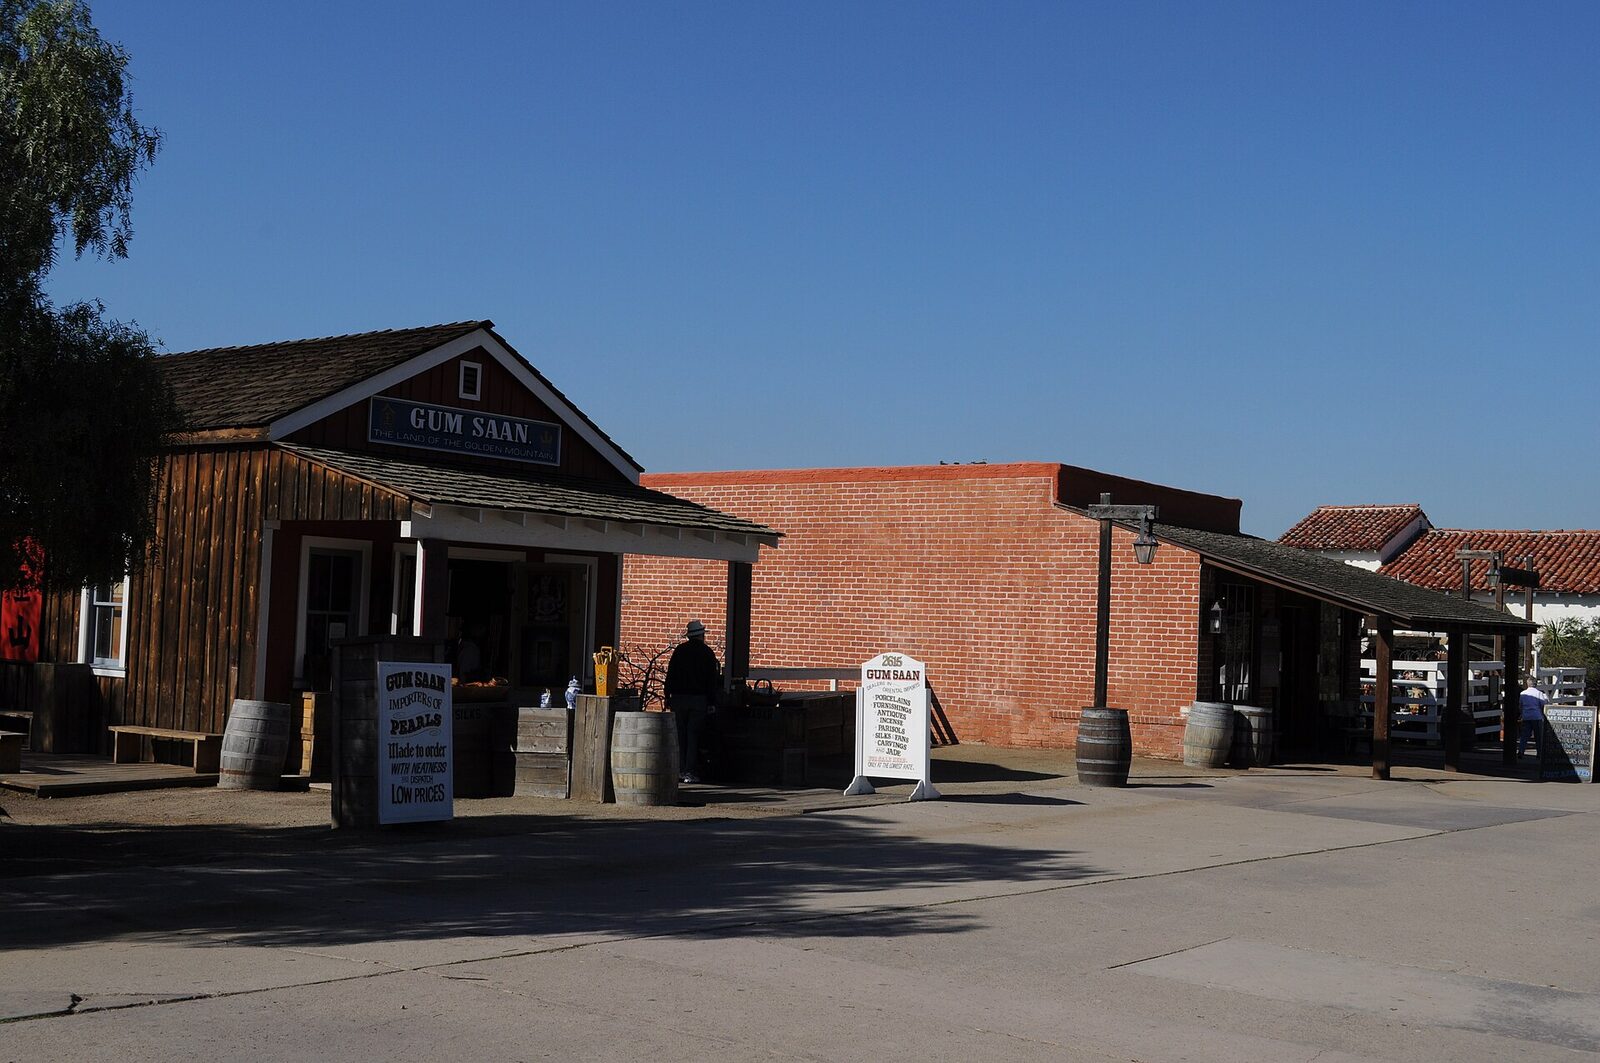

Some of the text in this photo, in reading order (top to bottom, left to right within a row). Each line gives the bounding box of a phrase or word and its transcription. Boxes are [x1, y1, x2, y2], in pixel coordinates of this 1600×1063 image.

[410, 407, 532, 445] GUM SAAN.
[373, 428, 394, 440] THE
[396, 432, 425, 444] LAND
[428, 435, 440, 445] OF
[444, 438, 462, 449] THE
[464, 440, 503, 453] GOLDEN
[881, 655, 903, 667] 2615
[866, 669, 920, 681] GUM SAAN
[386, 671, 446, 693] GUM SAAN
[389, 691, 443, 710] IMPORTERS OF
[875, 694, 911, 707] PORCELAINS
[873, 702, 912, 714] FURNISHINGS
[877, 709, 907, 720] ANTIQUES
[390, 713, 442, 735] PEARLS
[880, 717, 903, 727] INCENSE
[878, 724, 906, 735] PARISOLS
[875, 732, 892, 740] SILKS
[894, 734, 909, 744] FANS
[387, 742, 447, 759] Made to order
[877, 740, 907, 750] CARVINGS
[886, 748, 901, 756] JADE
[391, 761, 448, 775] WITH NEATNESS
[391, 783, 445, 804] LOW PRICES
